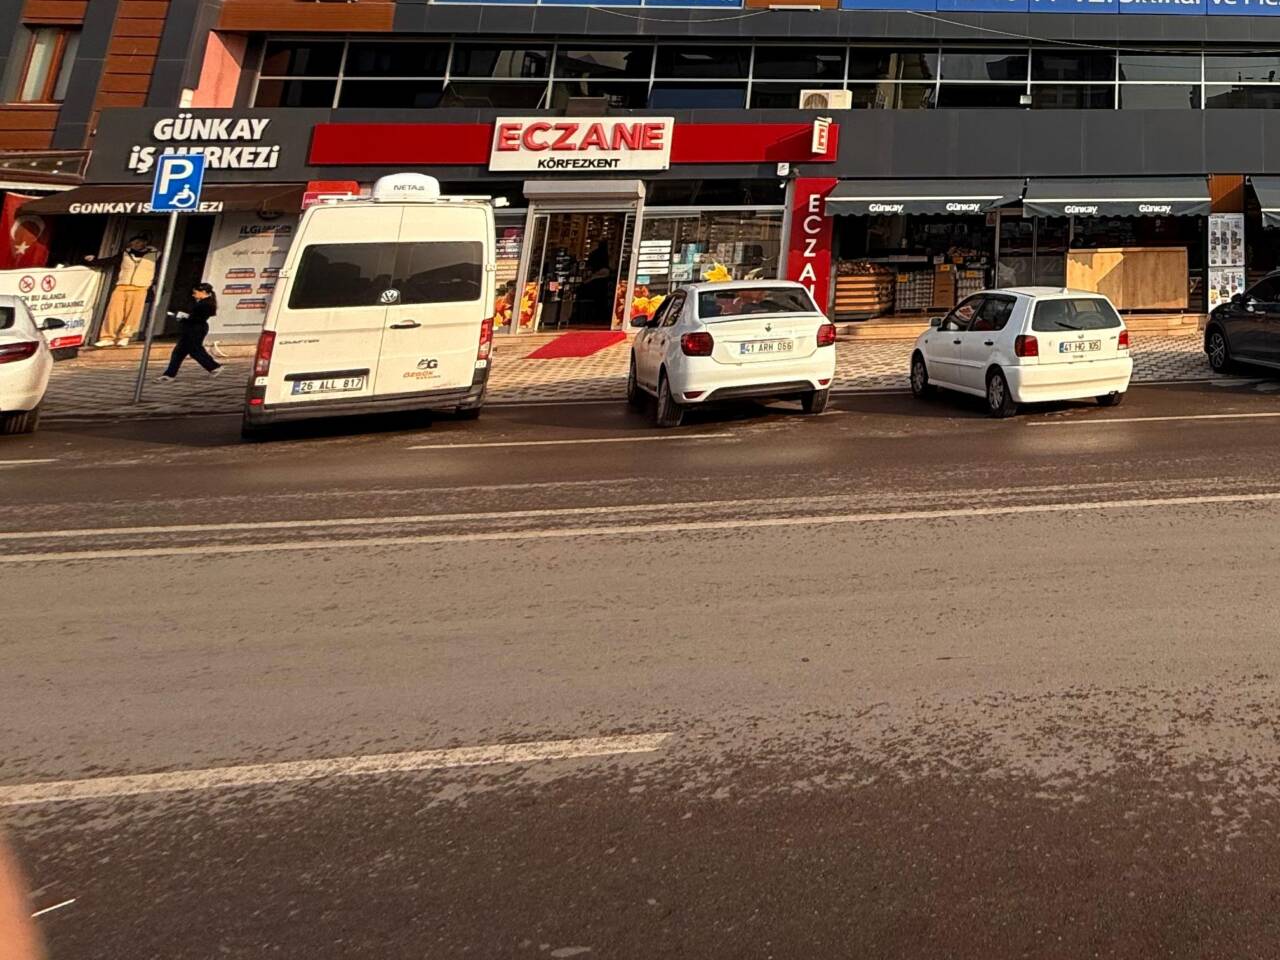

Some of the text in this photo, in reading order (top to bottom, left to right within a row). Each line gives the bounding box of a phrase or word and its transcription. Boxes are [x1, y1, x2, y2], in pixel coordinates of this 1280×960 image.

[153, 113, 270, 140] GÜNKAY
[496, 121, 665, 152] ECZANE
[537, 156, 621, 169] KÖRFEZKENT
[158, 158, 194, 195] P
[758, 342, 774, 352] ARH
[300, 382, 313, 391] 26
[319, 380, 337, 390] ALL
